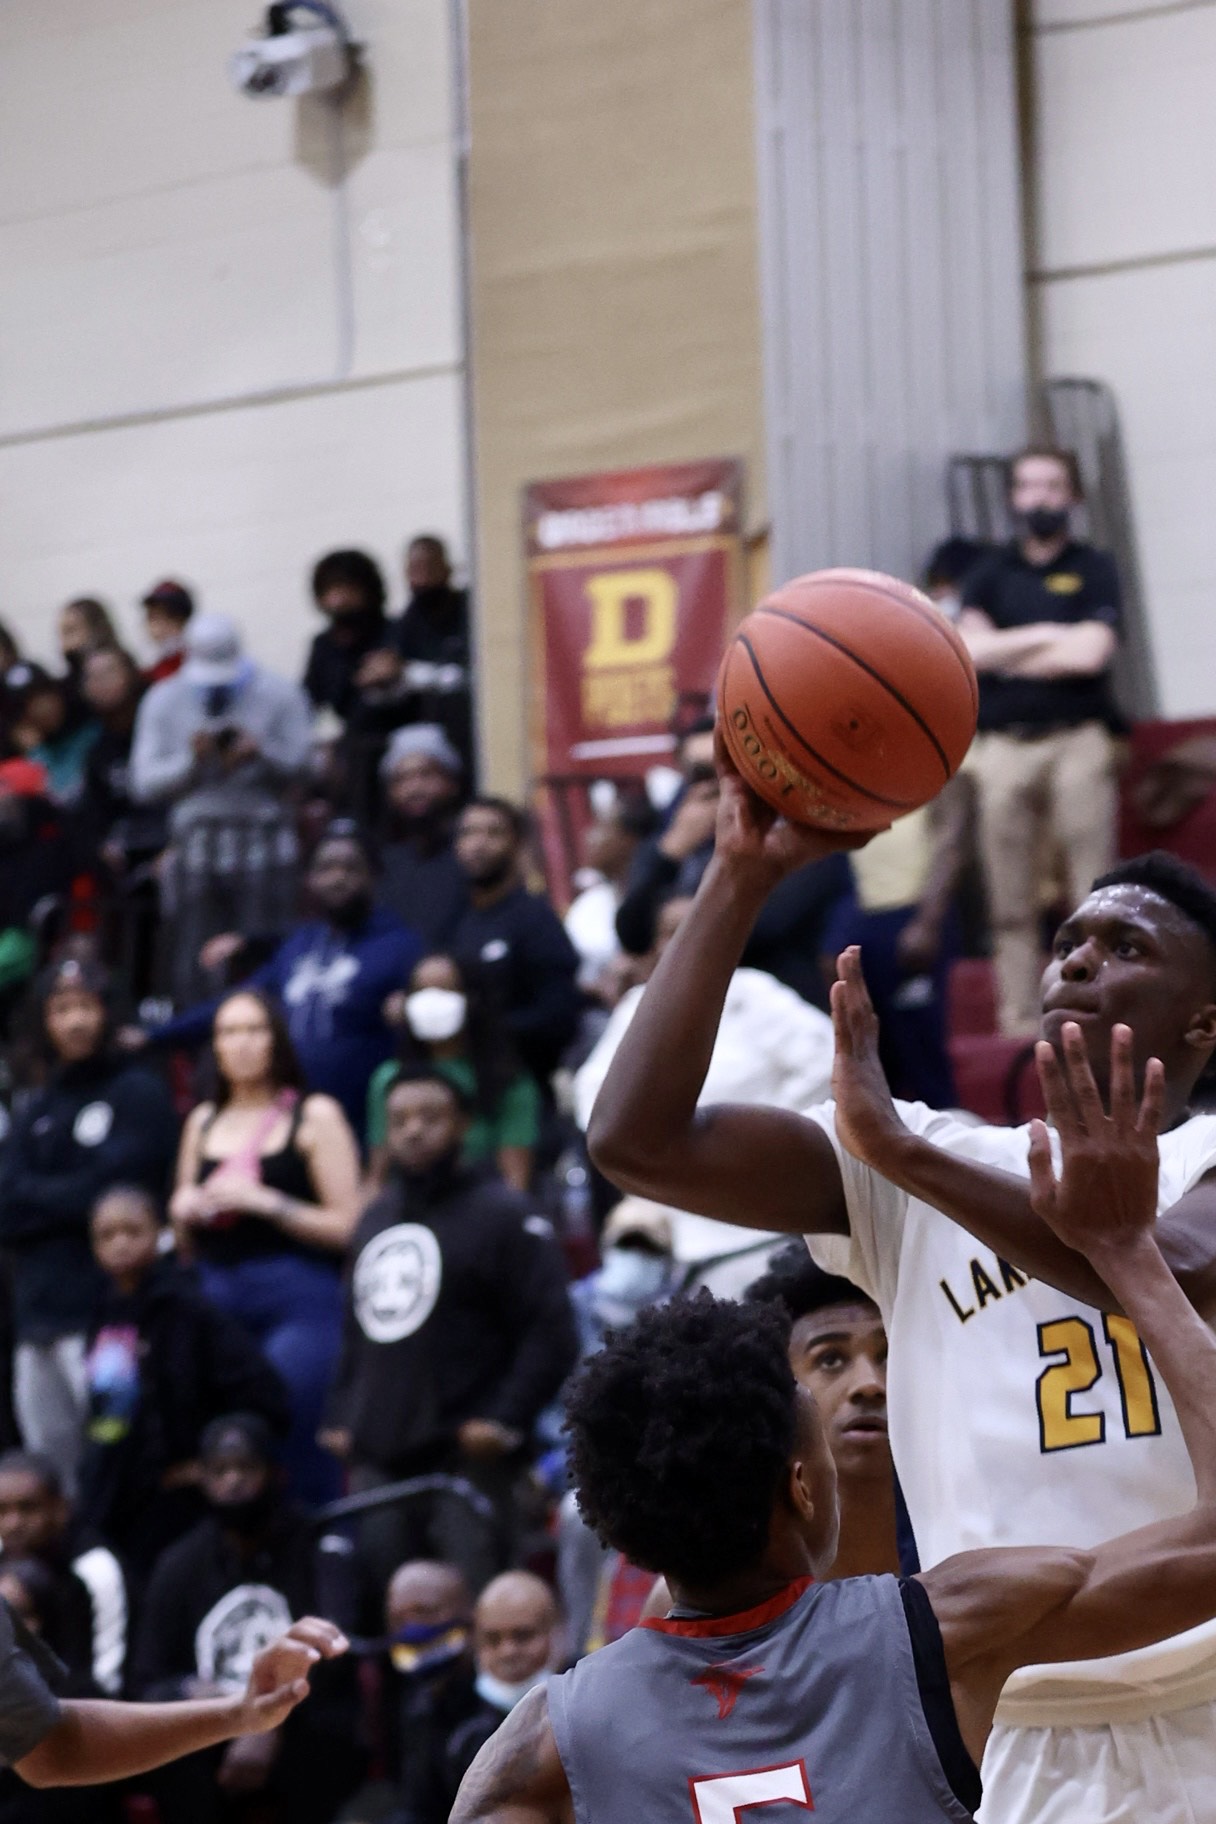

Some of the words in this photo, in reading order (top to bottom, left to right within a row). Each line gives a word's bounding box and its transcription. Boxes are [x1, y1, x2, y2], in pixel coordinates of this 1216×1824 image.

[582, 568, 676, 668] D
[940, 1255, 1033, 1323] LAK
[1036, 1311, 1162, 1453] 21
